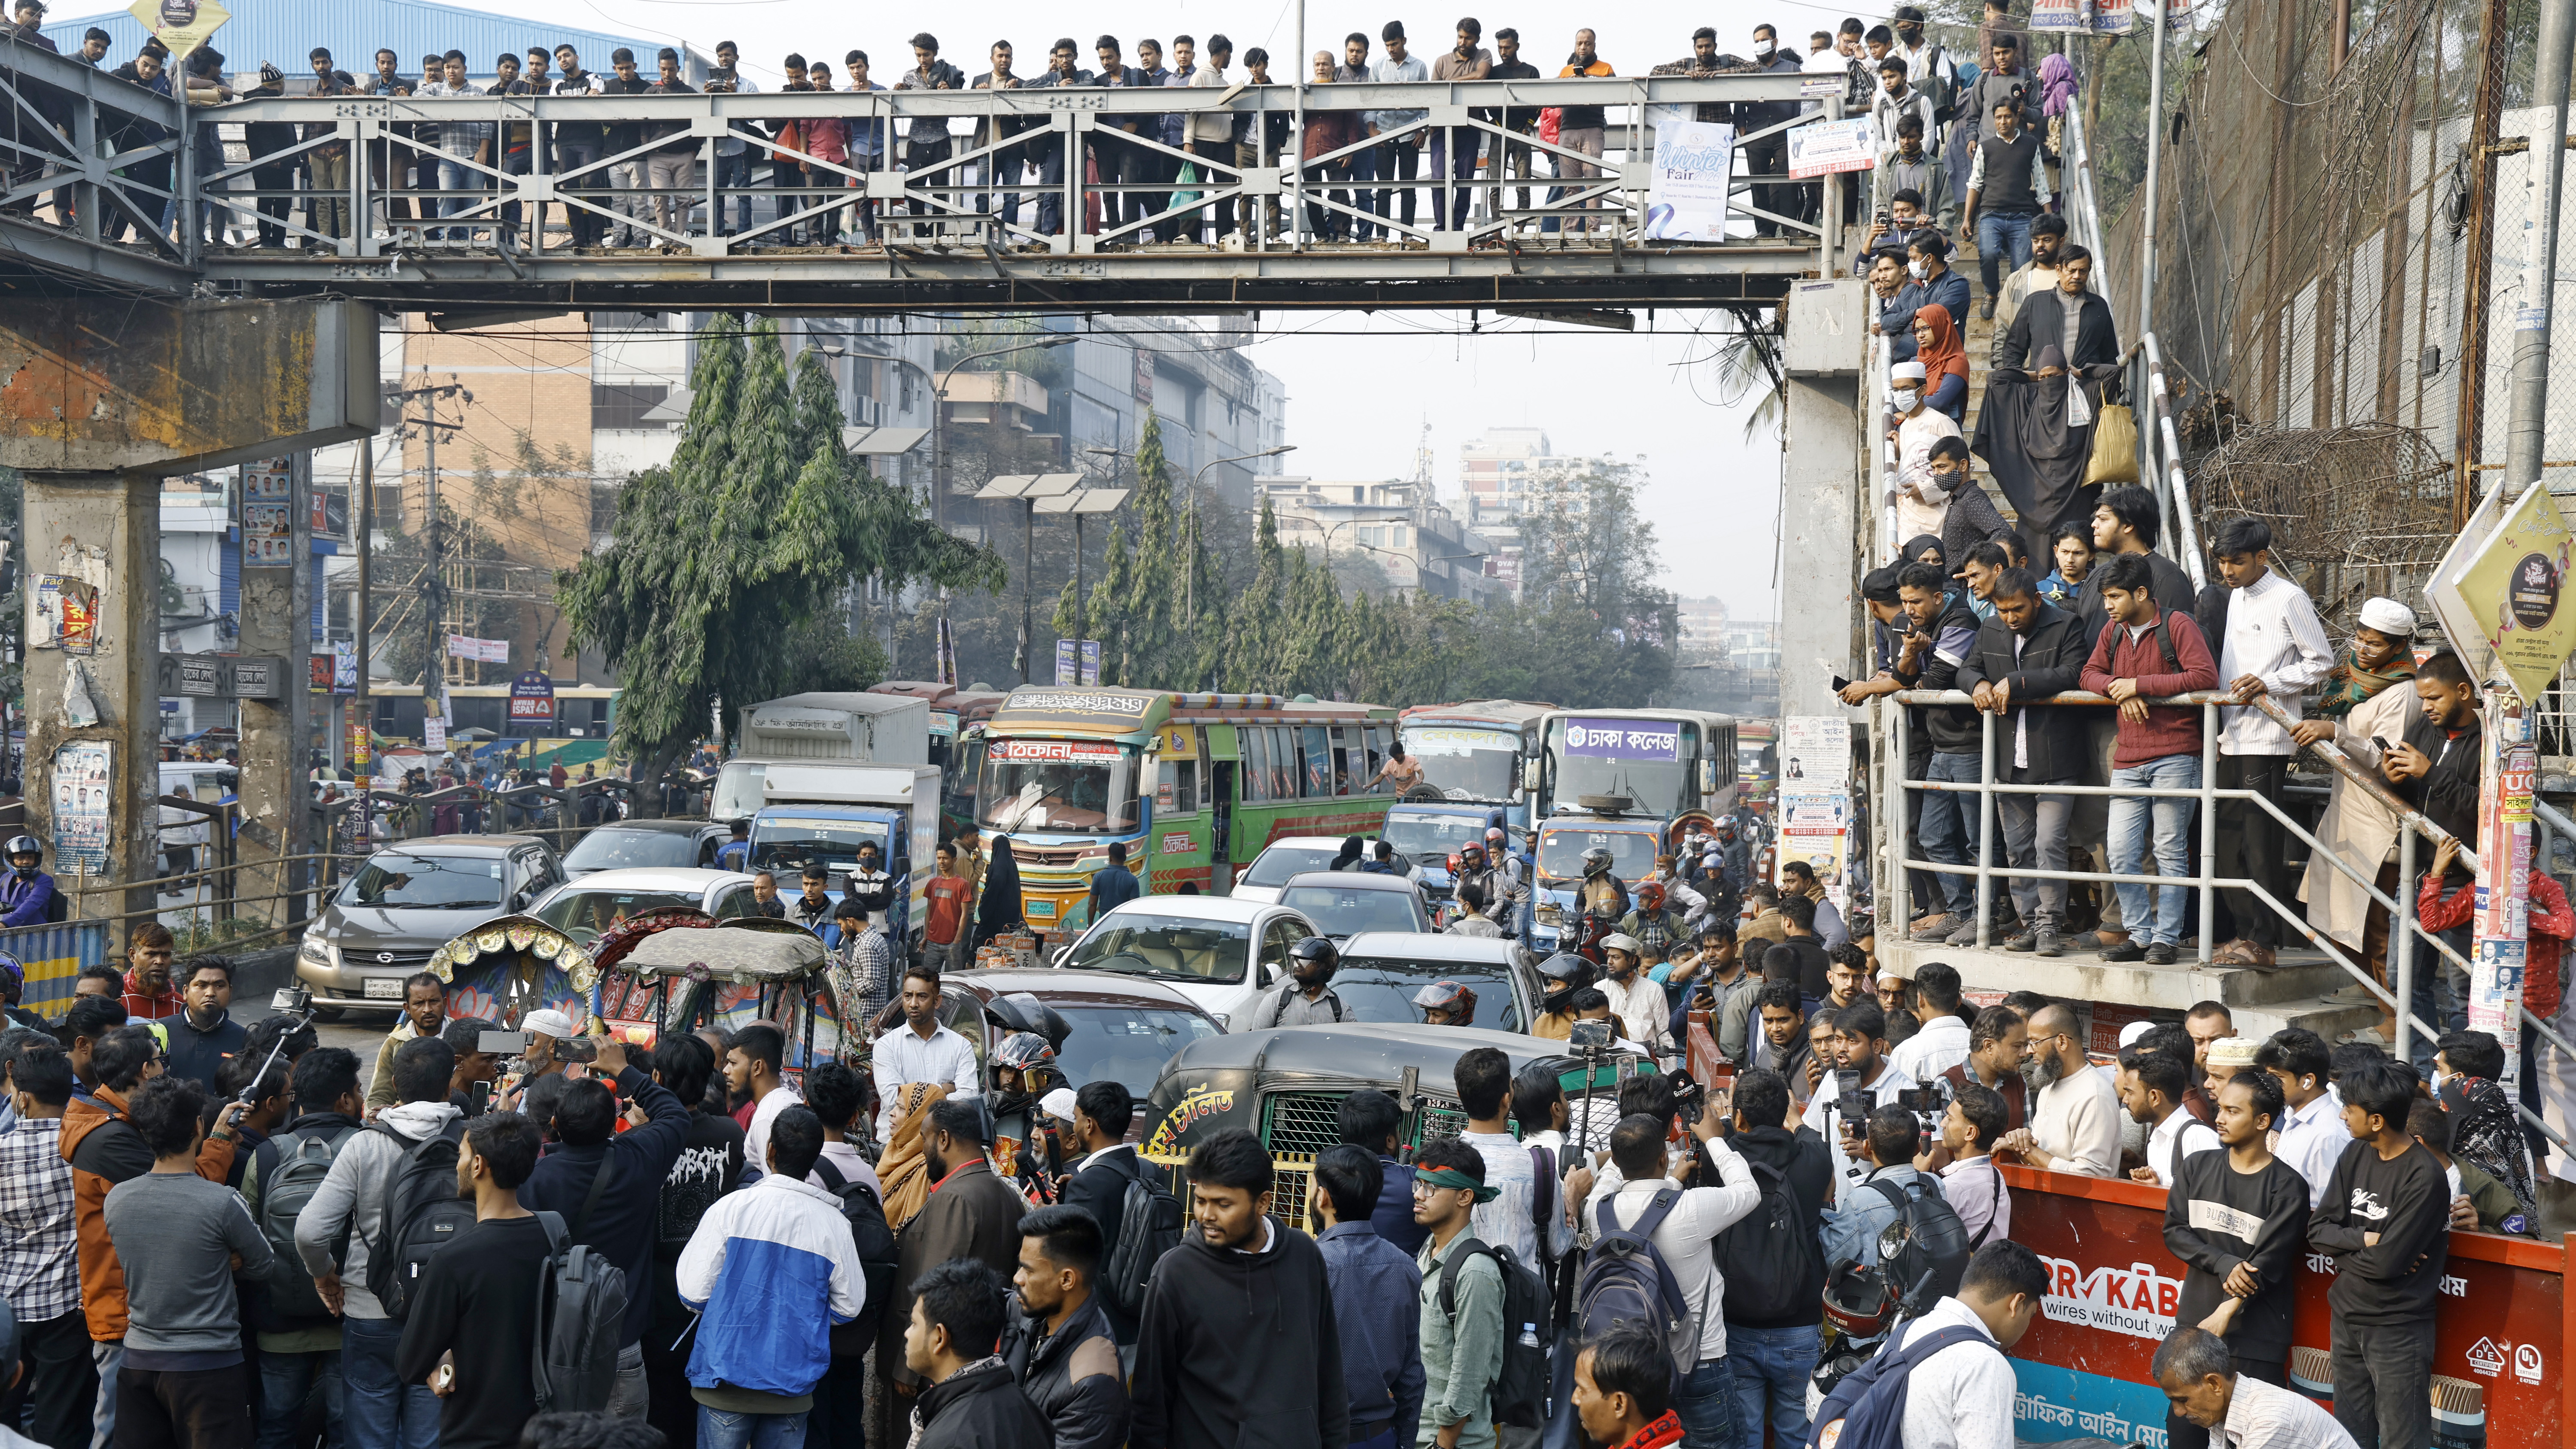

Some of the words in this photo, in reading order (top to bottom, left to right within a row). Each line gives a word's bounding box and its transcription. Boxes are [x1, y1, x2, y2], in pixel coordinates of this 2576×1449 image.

[1657, 141, 1728, 172] Winter
[1667, 169, 1694, 180] Fair
[1693, 171, 1721, 182] 2026
[2530, 562, 2545, 576] শুভ
[2524, 566, 2548, 587] উদ্বোধন
[183, 668, 199, 680] হাতের
[200, 670, 213, 681] লেখা
[238, 671, 253, 683] হাতের
[254, 672, 266, 682] লেখা
[513, 706, 535, 714] ISPAT
[1822, 719, 1845, 727] জাতীয়
[1421, 730, 1501, 744] মেঘলা
[1822, 727, 1844, 736] আইন
[1588, 729, 1624, 748] ঢাকা
[1627, 731, 1677, 752] কলেজ
[1008, 741, 1072, 757] ঠিকানা
[1163, 834, 1189, 853] ঠিকানা
[1984, 996, 2002, 1005] হোস্টে
[2095, 1008, 2113, 1020] সিটি
[1168, 1082, 1233, 1133] চালিত
[2107, 1269, 2179, 1317] KĀB
[2046, 1301, 2087, 1320] wires
[2092, 1309, 2149, 1333] without
[2474, 1360, 2496, 1369] CERTIFIED
[2521, 1349, 2535, 1367] UL
[2473, 1368, 2497, 1377] 40044228
[2517, 1369, 2540, 1378] CERTIFIED
[2523, 1378, 2540, 1386] 475305
[2014, 1392, 2075, 1427] ট্রাফিক
[2078, 1411, 2130, 1441] আইন
[2433, 1435, 2442, 1444] RR
